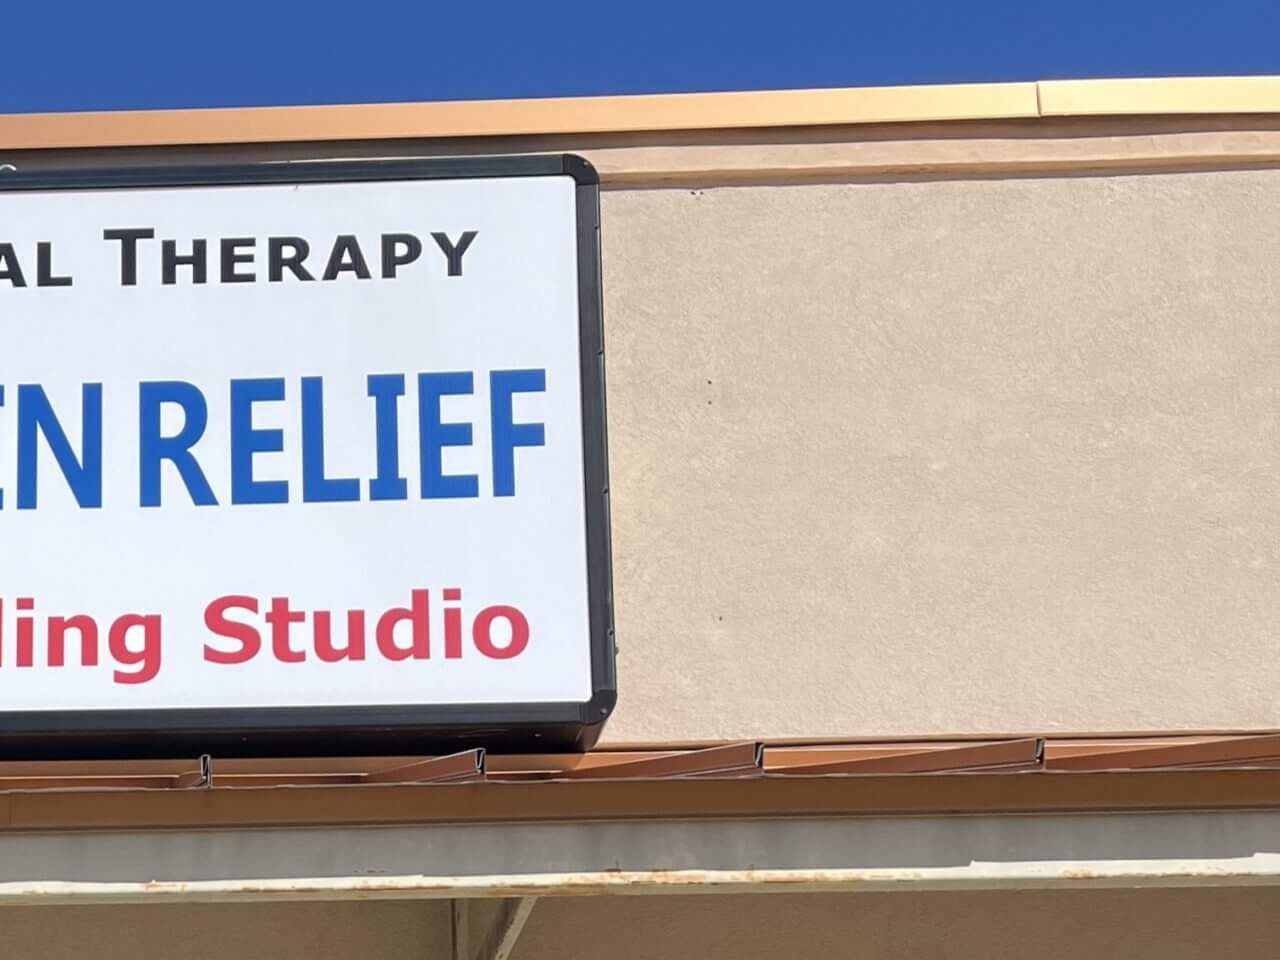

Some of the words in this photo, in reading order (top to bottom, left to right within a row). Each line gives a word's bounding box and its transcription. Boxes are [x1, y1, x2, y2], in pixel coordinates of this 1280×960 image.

[103, 228, 478, 286] THERAPY
[139, 370, 545, 507] RELIEF
[204, 589, 529, 664] Studio
